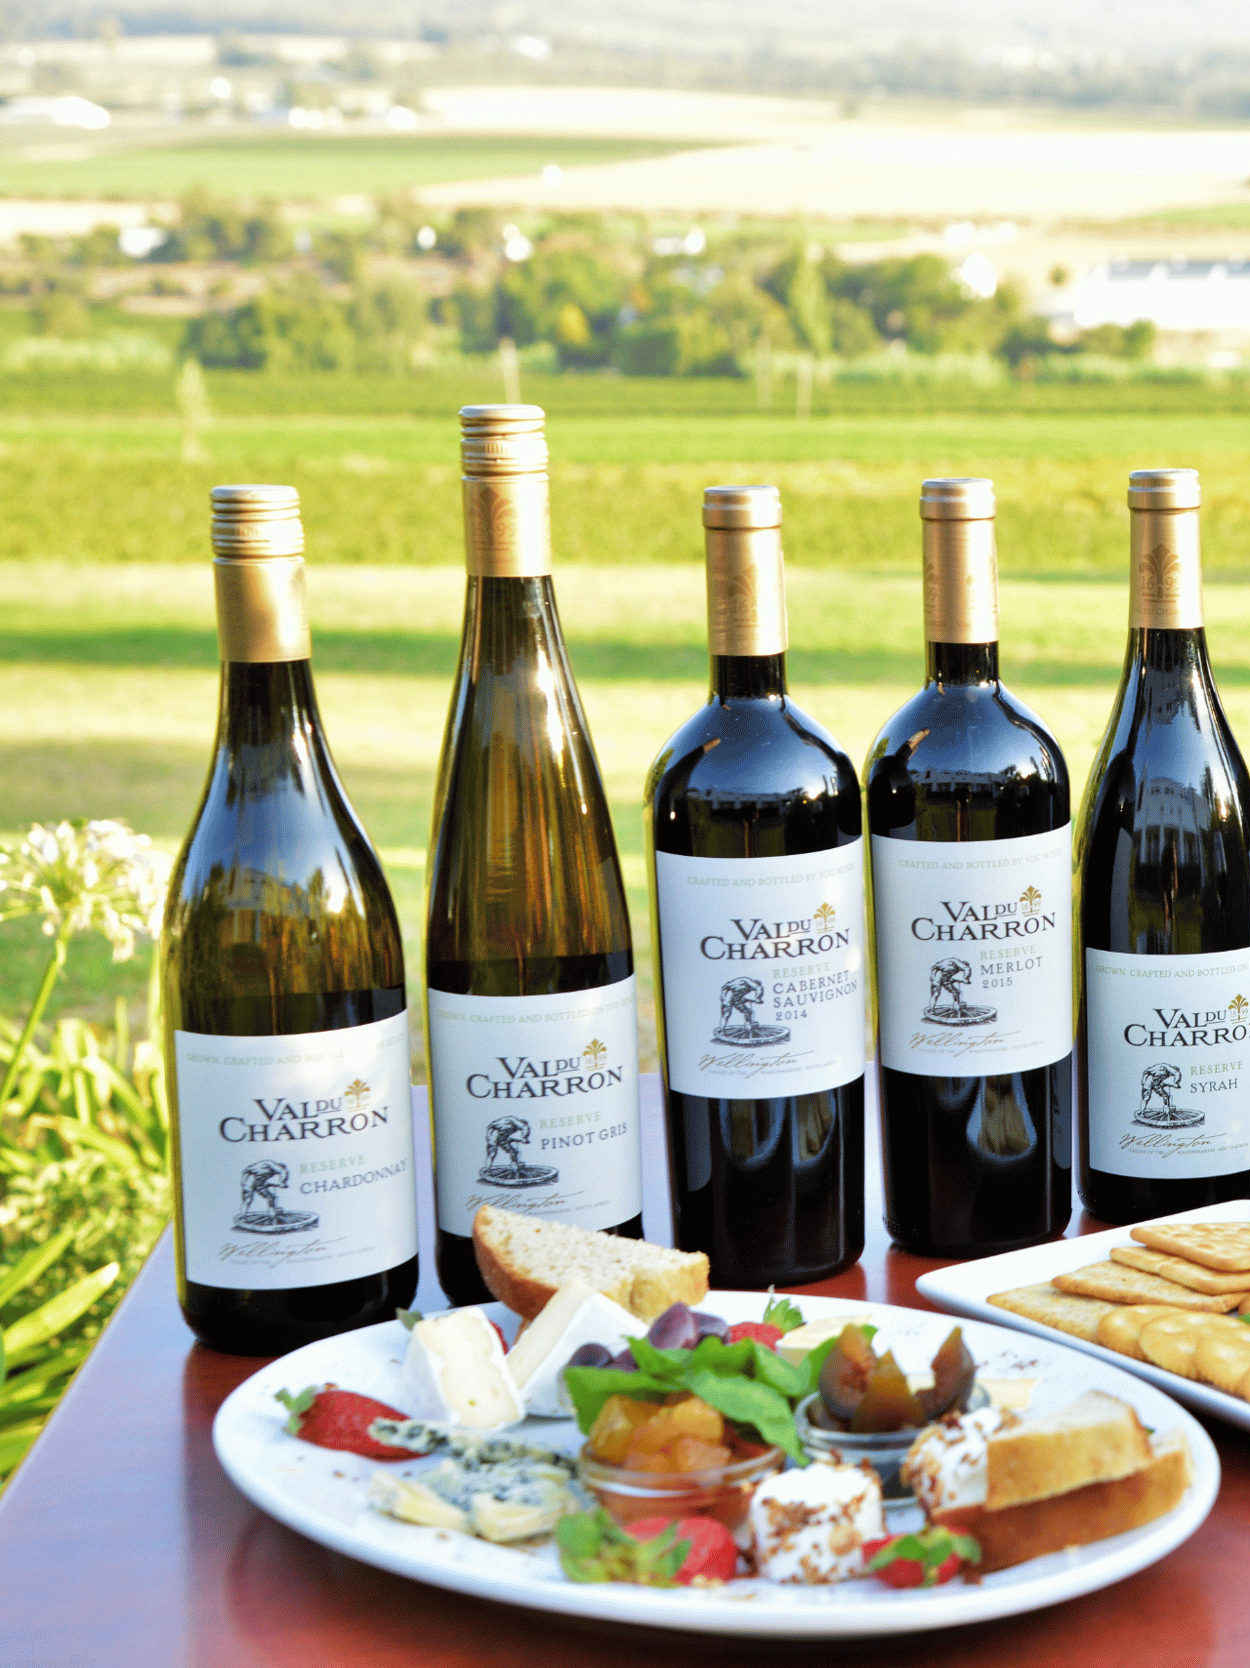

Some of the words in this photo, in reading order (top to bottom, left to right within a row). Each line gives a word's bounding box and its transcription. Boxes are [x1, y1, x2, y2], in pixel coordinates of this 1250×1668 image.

[899, 860, 939, 870] CRAFTED
[942, 860, 964, 870] AND
[967, 858, 1010, 869] BOTTLED
[687, 876, 730, 886] CRAFTED
[733, 877, 755, 886] AND
[758, 874, 804, 886] BOTTLED
[940, 901, 998, 922] VAL
[995, 903, 1017, 915] DU
[730, 919, 791, 940] VAL
[789, 919, 812, 933] DU
[911, 912, 1057, 941] CHARRON
[699, 928, 850, 959] CHARRON
[980, 945, 1036, 960] RESERVE
[772, 962, 830, 979] RESERVE
[981, 957, 1043, 975] MERLOT
[1130, 969, 1172, 978] CRAFTED
[1174, 968, 1195, 977] AND
[1197, 966, 1236, 976] BOTTLED
[1237, 964, 1248, 972] ON
[773, 970, 850, 994] CABERNET
[982, 978, 1013, 988] 2015
[773, 980, 858, 1008] SAUVIGNON
[469, 1013, 516, 1024] CRAFTED
[518, 1014, 542, 1023] AND
[545, 1008, 589, 1022] BOTTLED
[775, 1010, 808, 1021] 2014
[1153, 1008, 1208, 1029] VAL
[1205, 1010, 1227, 1022] DU
[224, 1055, 273, 1066] CRAFTED
[277, 1054, 302, 1065] AND
[495, 1057, 559, 1079] VAL
[555, 1057, 581, 1071] DU
[1190, 1060, 1243, 1075] RESERVE
[466, 1066, 624, 1099] CHARRON
[1190, 1078, 1239, 1094] SYRAH
[252, 1097, 320, 1121] VAL
[315, 1097, 343, 1112] DU
[219, 1106, 389, 1143] CHARRON
[540, 1111, 601, 1129] RESERVE
[541, 1131, 596, 1150] PINOT
[599, 1122, 628, 1140] GRIS
[1119, 1133, 1227, 1158] Wellington
[299, 1155, 365, 1174] RESERVE
[299, 1158, 408, 1195] CHARDONNAY
[465, 1191, 584, 1214] Wllington
